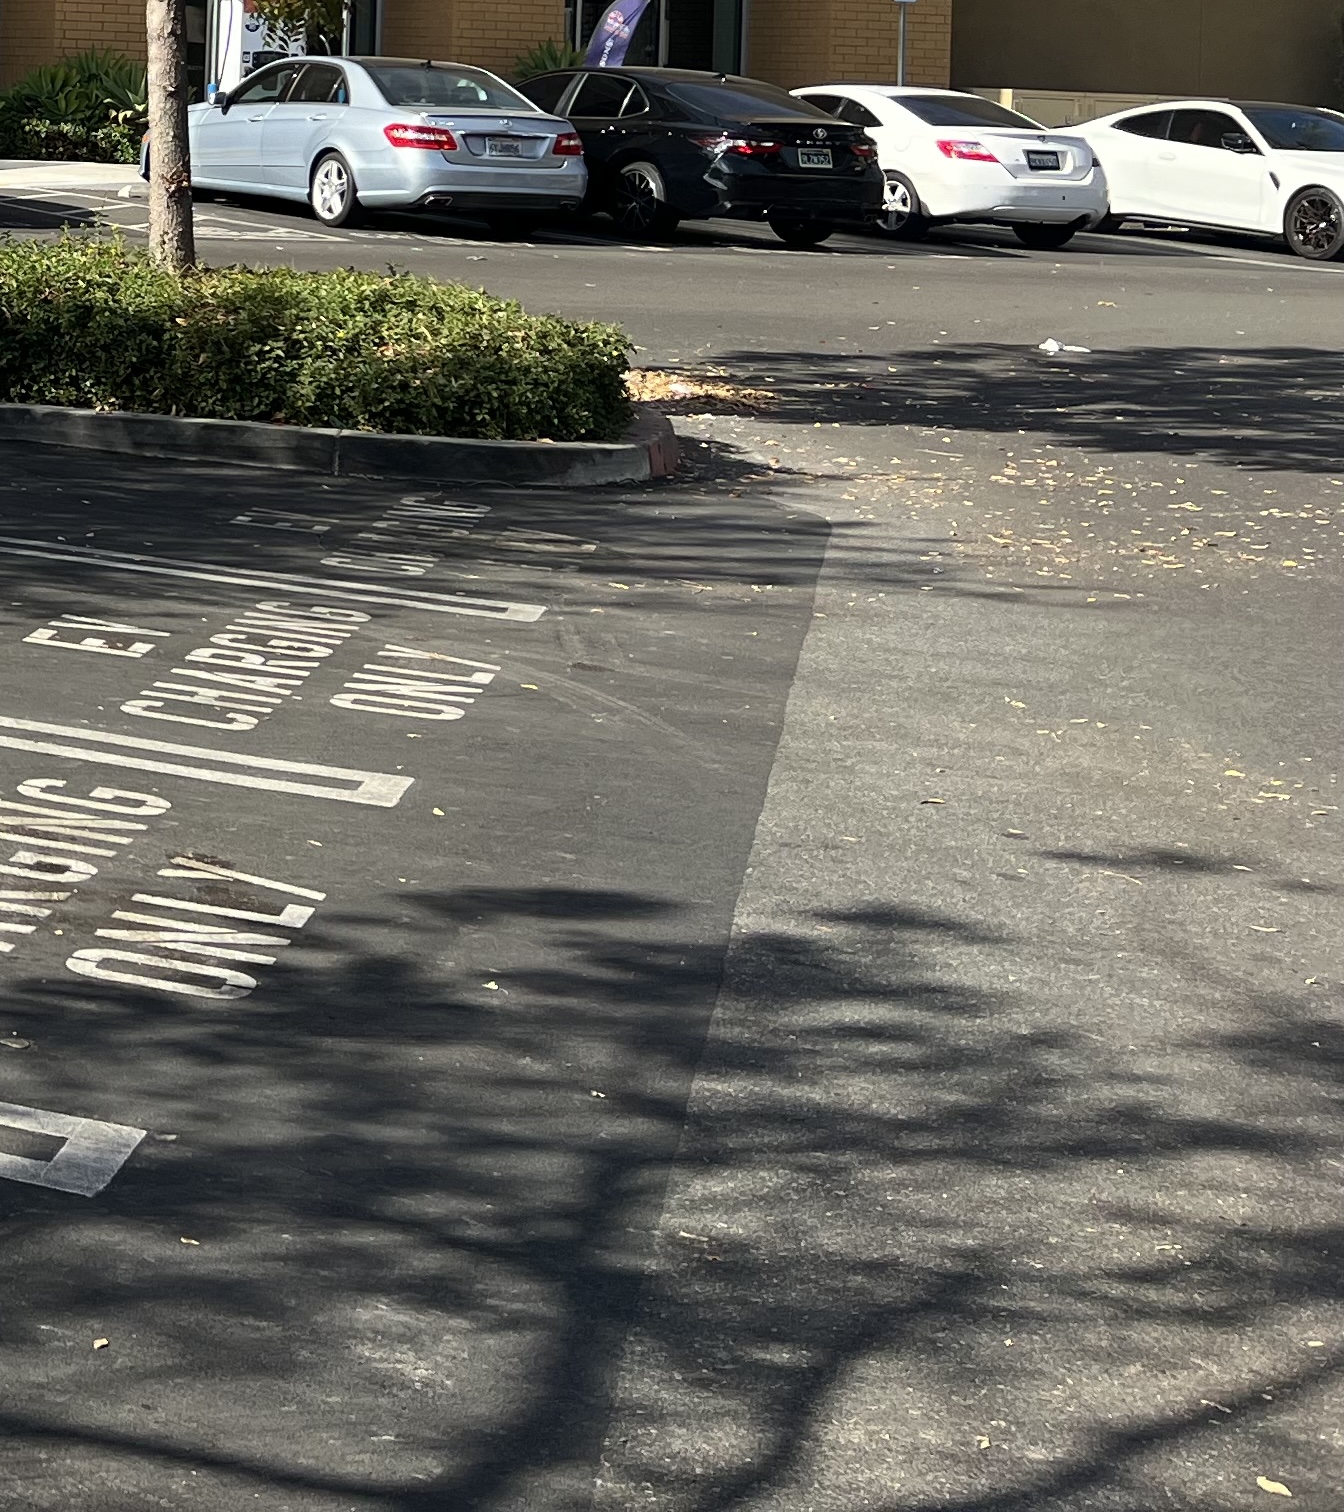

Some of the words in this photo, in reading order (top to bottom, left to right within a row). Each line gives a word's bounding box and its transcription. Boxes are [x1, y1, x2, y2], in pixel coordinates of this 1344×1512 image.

[22, 612, 171, 659] EV
[120, 600, 372, 732] CHARGING
[329, 643, 502, 721] ONLY
[64, 856, 327, 1001] ONLY
